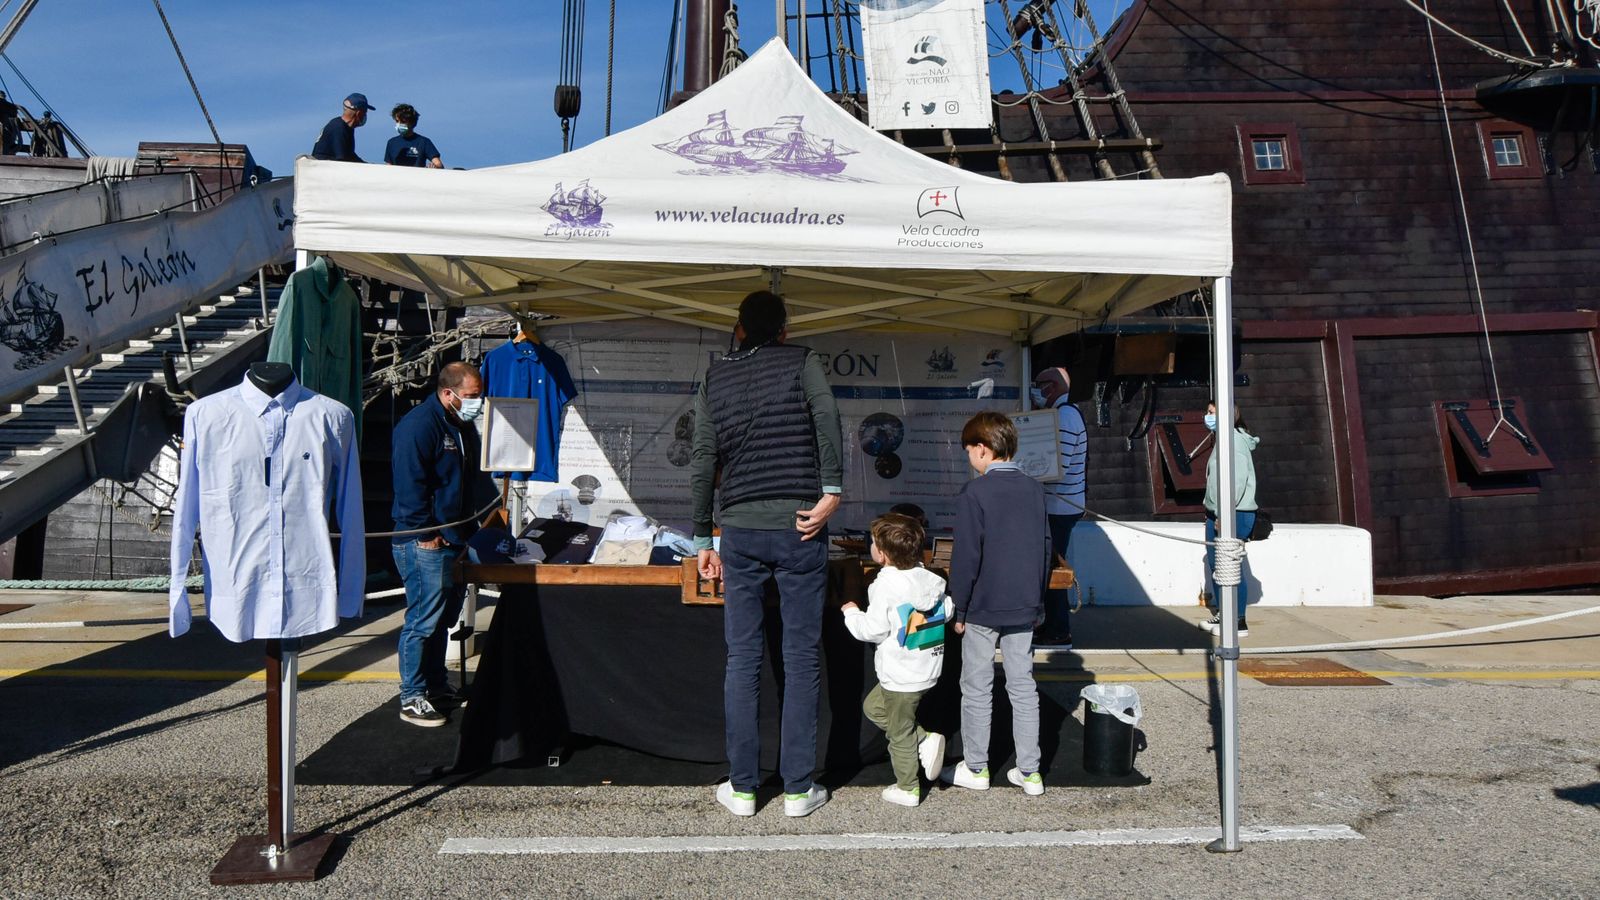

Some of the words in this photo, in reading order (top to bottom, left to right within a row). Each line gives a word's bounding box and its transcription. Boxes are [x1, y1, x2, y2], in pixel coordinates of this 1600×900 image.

[929, 68, 950, 76] NAO
[906, 76, 950, 85] VICTORIA
[654, 206, 846, 226] www.velacuadra.es
[902, 224, 930, 236] Vela
[932, 224, 980, 237] Cuadra
[897, 237, 984, 249] Producciones
[76, 260, 115, 317] El
[121, 236, 196, 317] Galeón
[817, 349, 880, 377] EÓN
